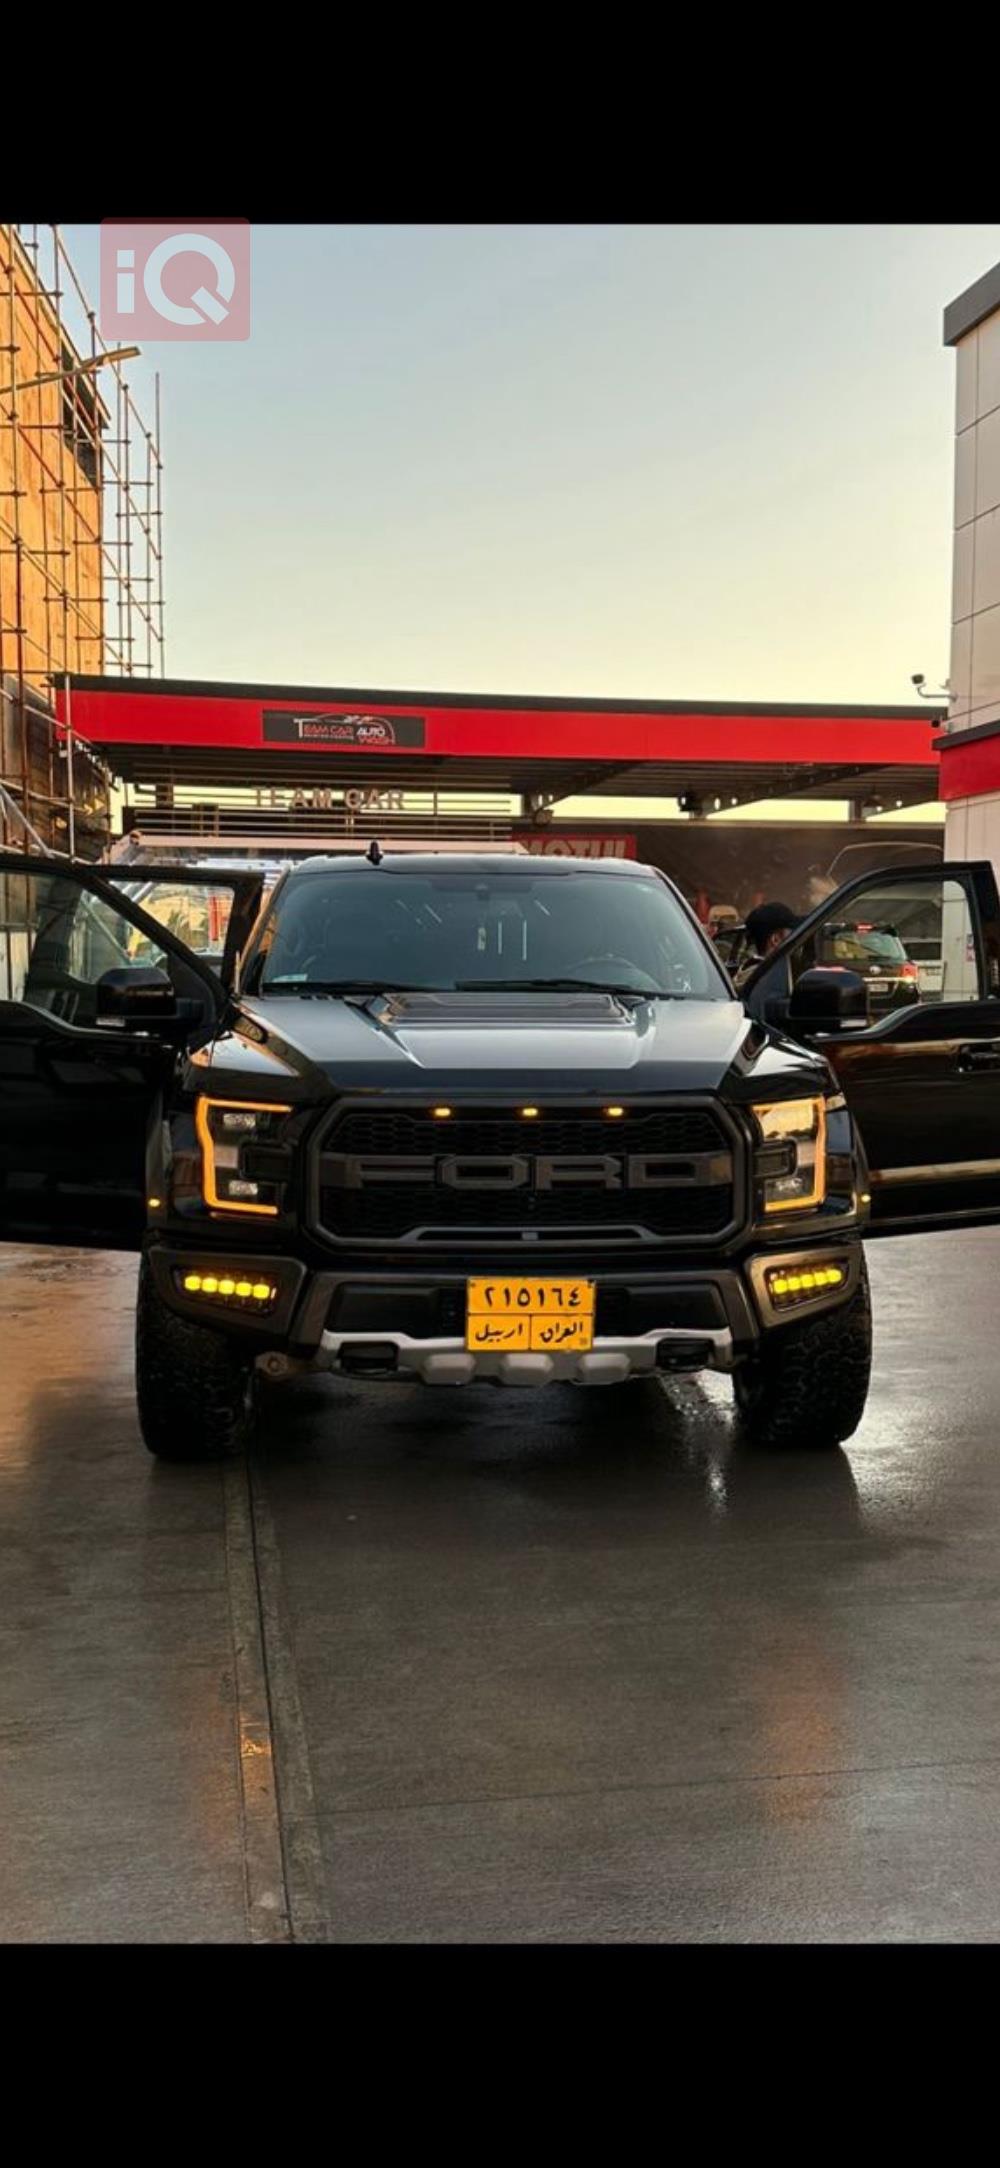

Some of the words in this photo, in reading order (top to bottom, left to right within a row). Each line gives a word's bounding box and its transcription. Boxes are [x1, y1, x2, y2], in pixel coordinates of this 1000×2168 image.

[293, 718, 329, 738] TEAM
[330, 725, 354, 736] CAR
[356, 726, 386, 737] AUTO
[252, 786, 333, 809] TEAM
[344, 788, 404, 810] CAR
[344, 1153, 713, 1190] FORD
[484, 1287, 580, 1307] ٢١٥١٦٤
